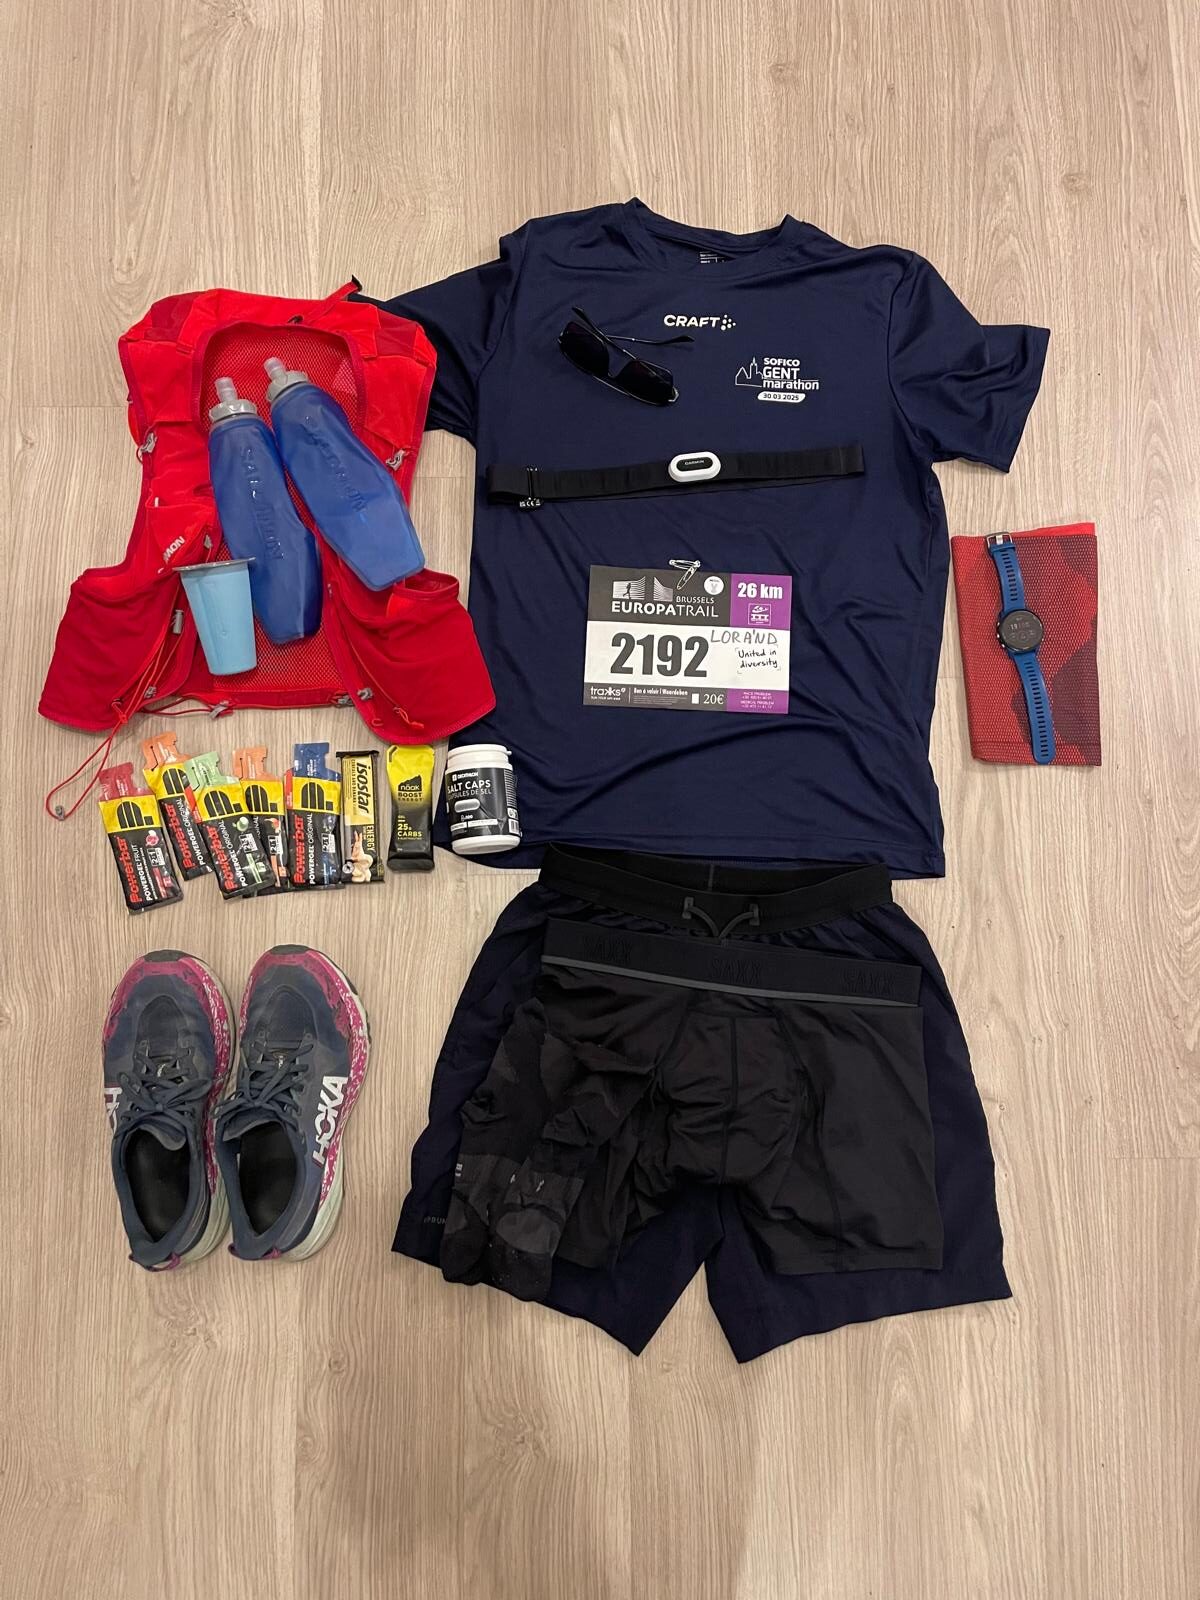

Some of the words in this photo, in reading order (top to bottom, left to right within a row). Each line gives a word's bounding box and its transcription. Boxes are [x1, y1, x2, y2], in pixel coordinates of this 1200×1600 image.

[664, 315, 720, 328] CRAFT
[764, 357, 800, 366] SOFICO
[763, 367, 800, 379] GENT
[763, 379, 819, 390] marathon
[737, 582, 757, 598] 26
[760, 583, 783, 599] km
[676, 596, 714, 604] BRUSSELS
[611, 601, 719, 617] EUROPATRAIL
[610, 632, 709, 678] 2192
[740, 658, 778, 669] diversity
[703, 693, 724, 704] 20€
[356, 762, 369, 814] isostar
[447, 781, 463, 793] SALT
[465, 779, 491, 789] CAPS
[166, 803, 195, 868] Powerbar
[366, 825, 375, 851] ENERGY
[131, 844, 140, 859] FRUIT
[293, 815, 305, 884] Powerbar
[117, 837, 142, 903] Powerbar
[135, 859, 153, 901] POWERGEL
[312, 1076, 348, 1165] HOKA
